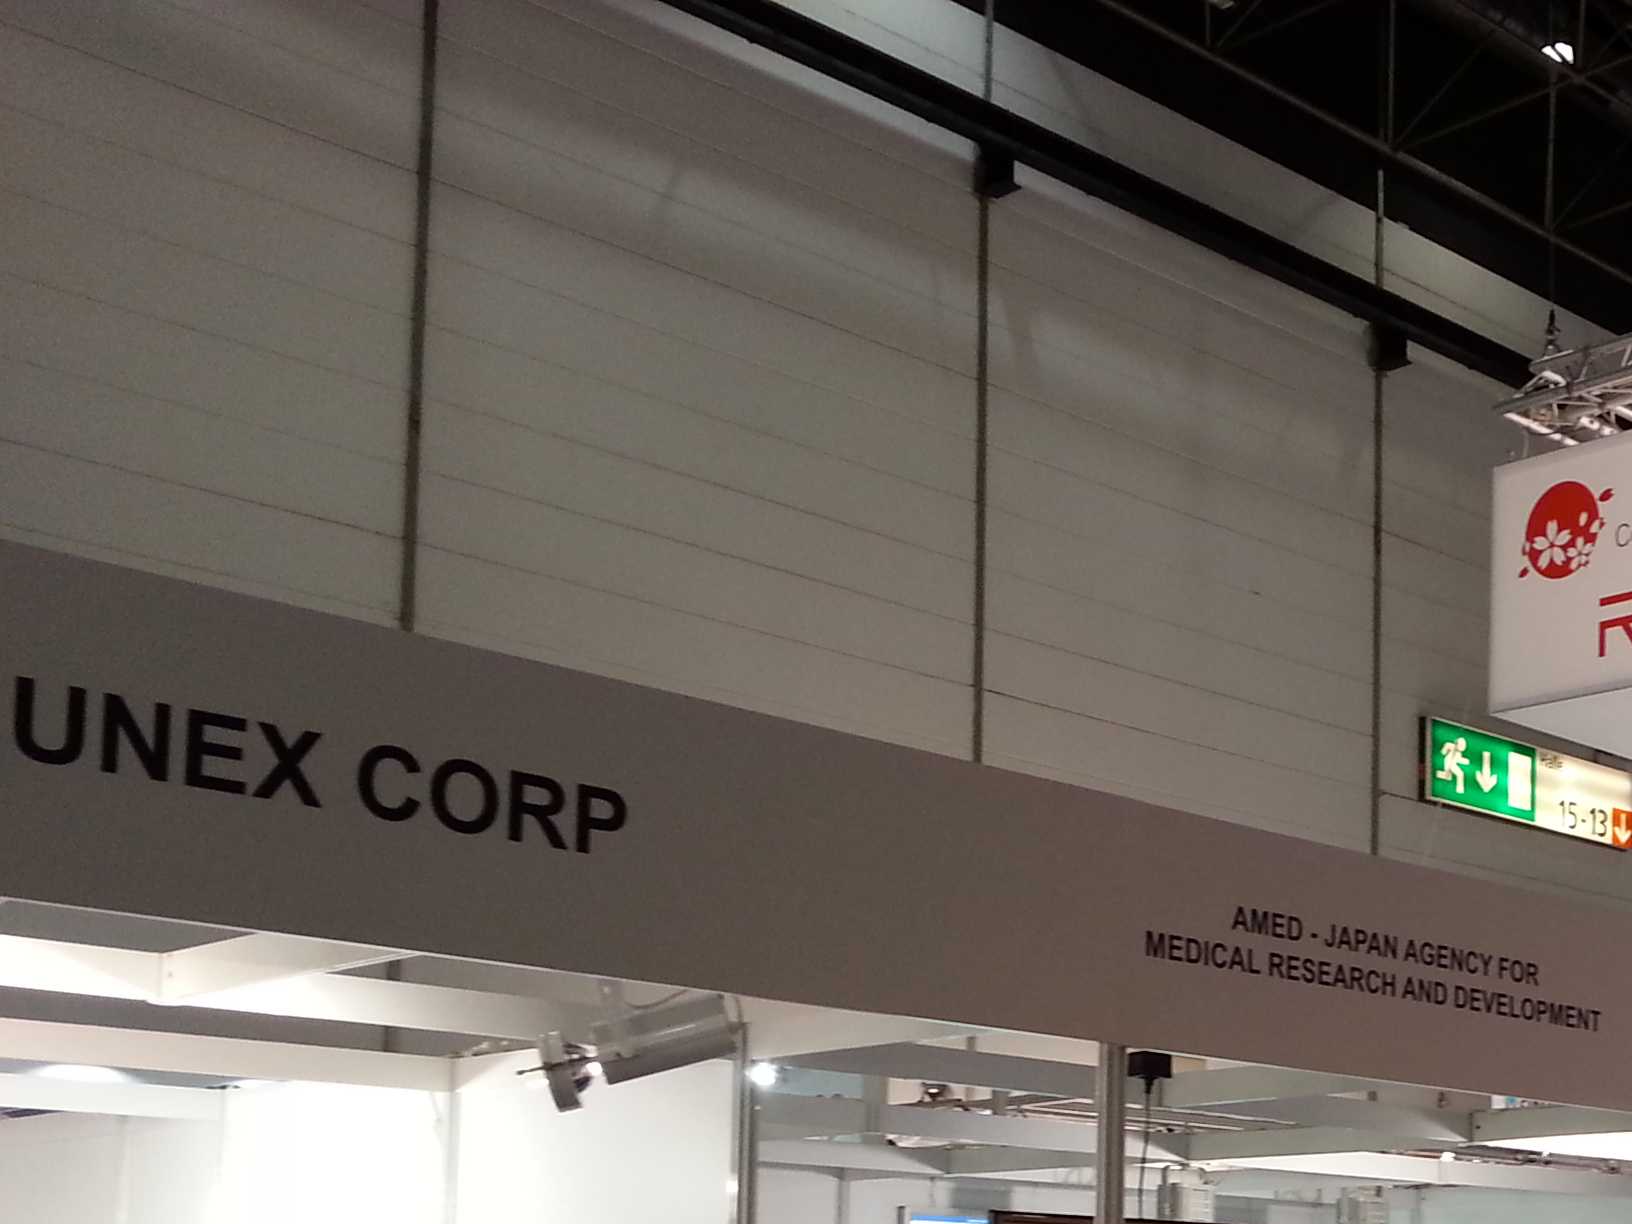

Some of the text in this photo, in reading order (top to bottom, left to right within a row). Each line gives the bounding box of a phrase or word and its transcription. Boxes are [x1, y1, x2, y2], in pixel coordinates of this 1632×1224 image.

[13, 676, 627, 854] UNEX CORP
[1145, 929, 1601, 1033] MEDICAL RESEARCH AND DEVELOPMENT
[1231, 905, 1302, 941] AMED
[1324, 924, 1398, 960] JAPAN
[1403, 939, 1493, 979] AGENCY
[1498, 957, 1540, 987] FOR
